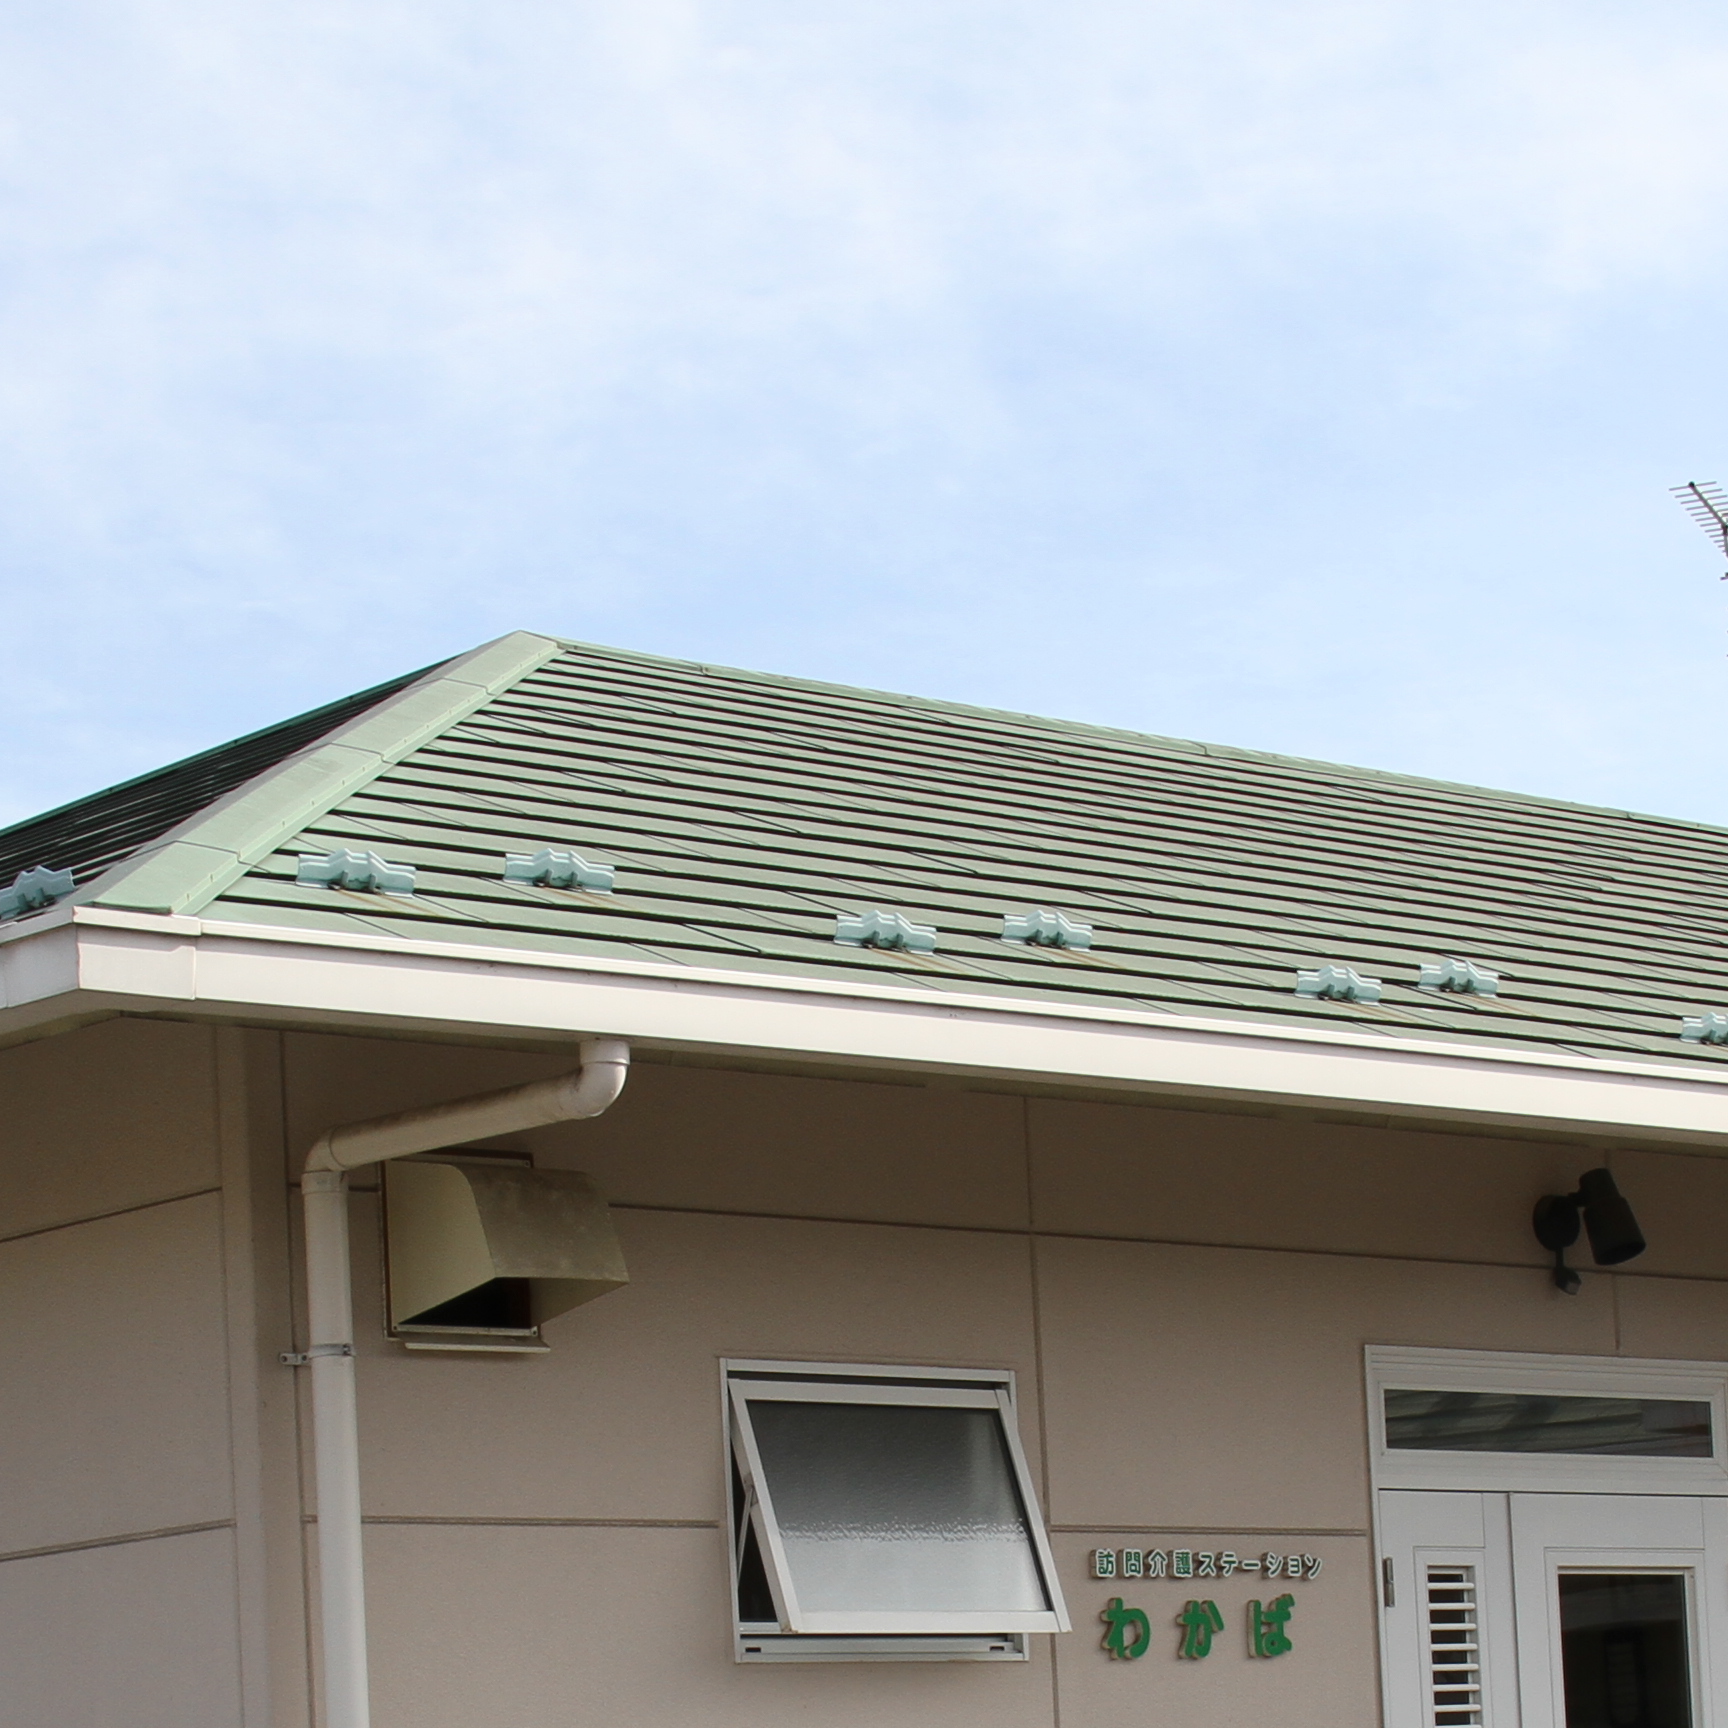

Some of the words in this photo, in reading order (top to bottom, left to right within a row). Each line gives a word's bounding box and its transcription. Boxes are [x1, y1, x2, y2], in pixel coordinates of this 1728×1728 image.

[1091, 1548, 1322, 1580] 訪問介護ステーション
[1100, 1593, 1295, 1659] わかば
